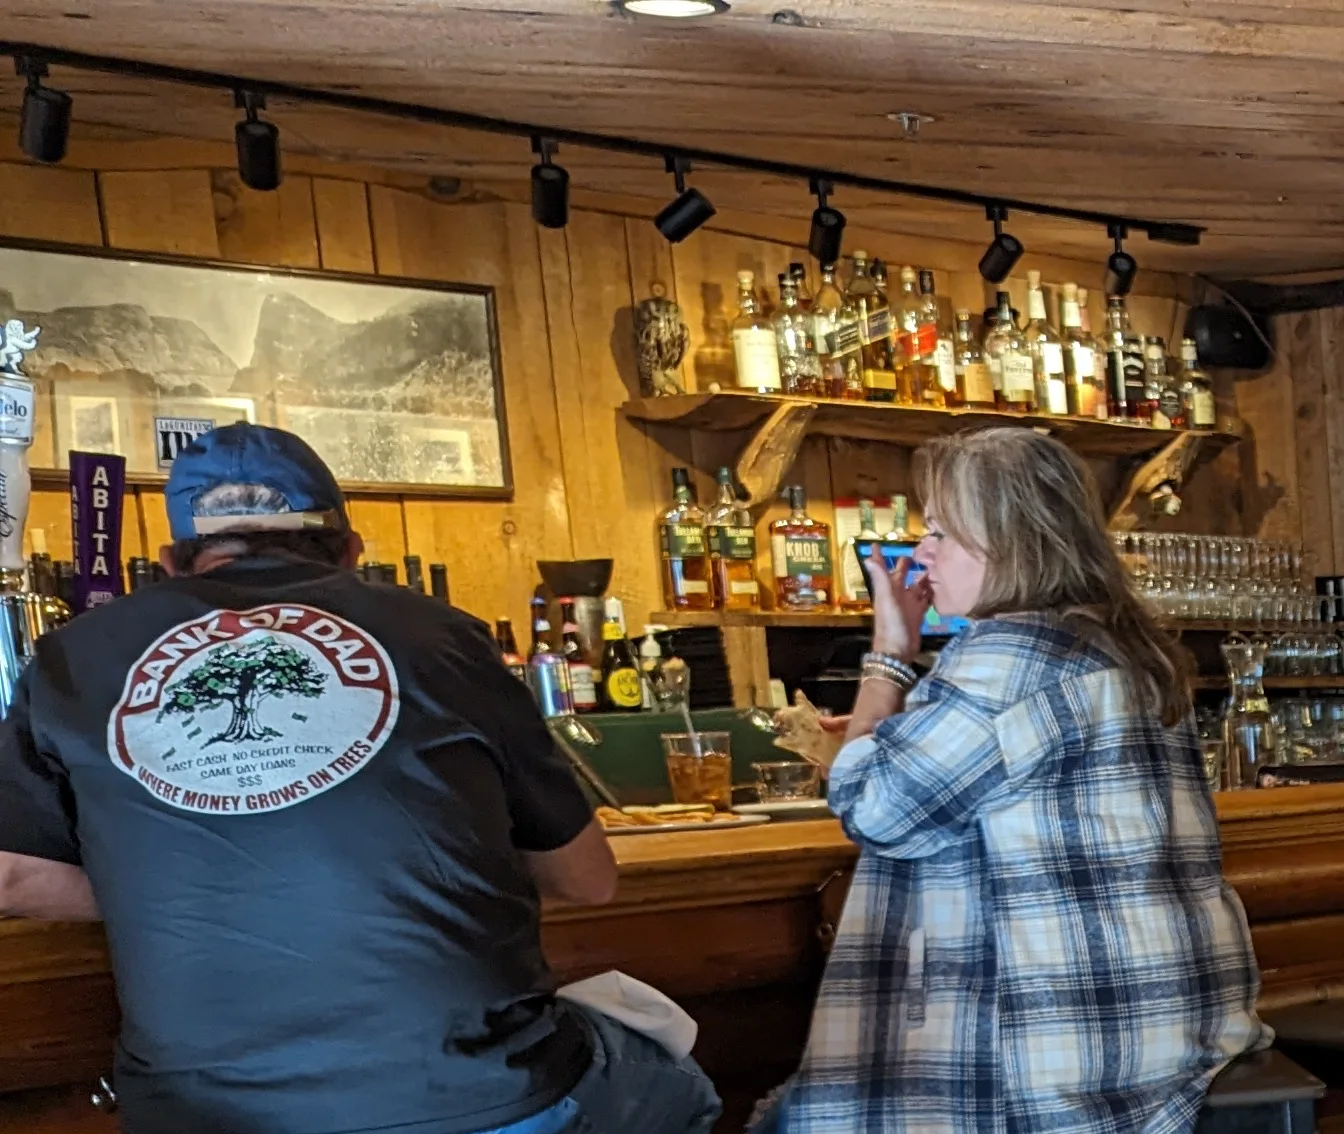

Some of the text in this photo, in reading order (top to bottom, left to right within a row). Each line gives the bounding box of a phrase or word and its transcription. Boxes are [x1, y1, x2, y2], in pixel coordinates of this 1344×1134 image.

[0, 398, 28, 418] elo
[160, 430, 204, 461] IP
[71, 485, 81, 575] ABITA
[92, 465, 110, 576] ABITA
[786, 541, 820, 558] KNOB
[129, 608, 381, 708] BANK OF DAD
[165, 745, 335, 773] FAST CASH NO CREDIT CHECK
[200, 759, 297, 780] SAME DAY LOANS
[138, 740, 373, 811] WHERE MONEY GROWS ON TREES
[237, 775, 263, 788] $$$
